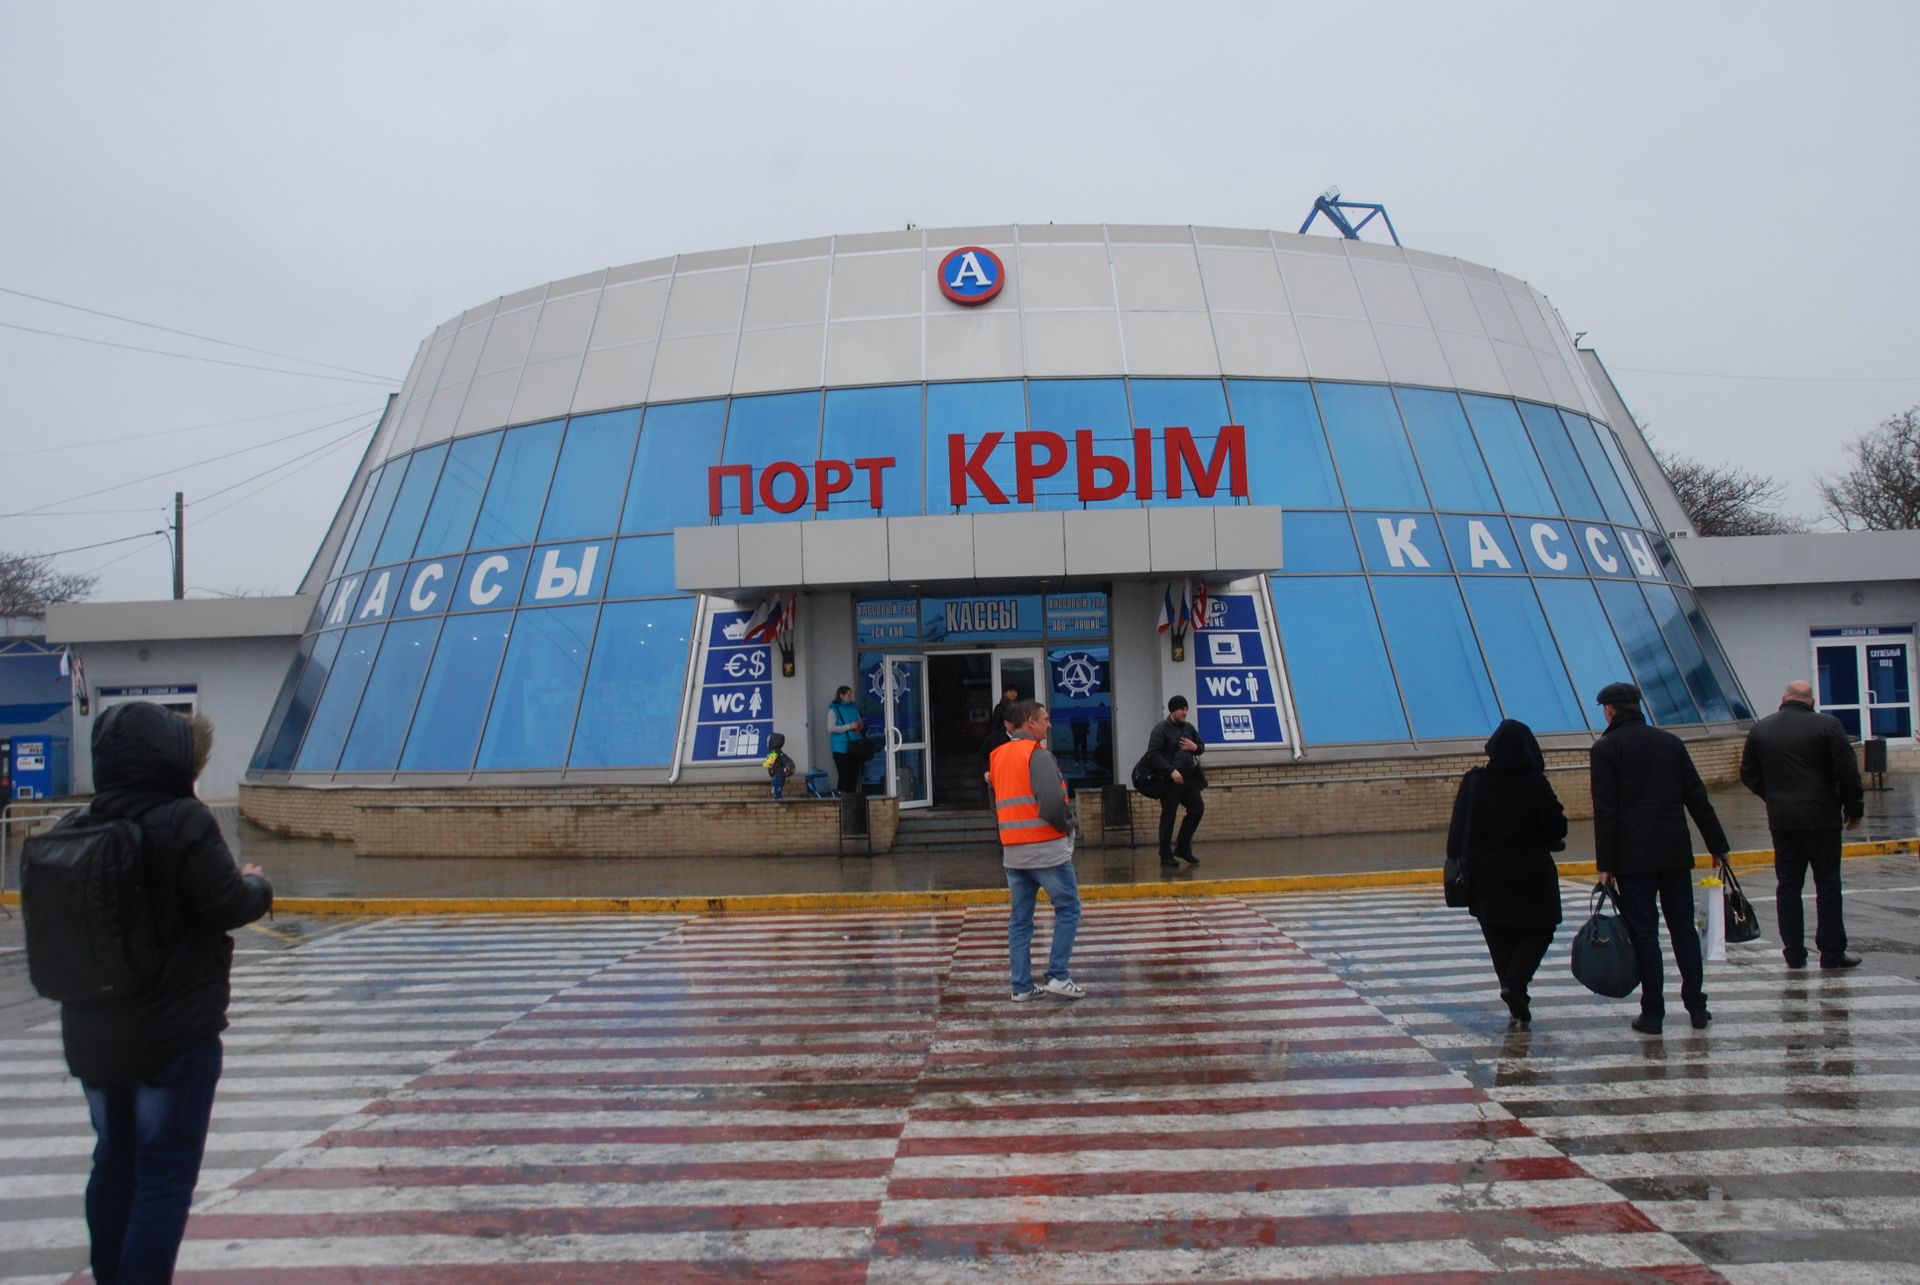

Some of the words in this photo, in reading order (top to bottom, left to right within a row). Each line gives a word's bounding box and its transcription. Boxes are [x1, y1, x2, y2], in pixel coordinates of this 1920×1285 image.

[708, 456, 896, 516] ПОРТ
[946, 425, 1248, 506] КРЫМ
[1375, 518, 1660, 578] КАССЫ
[329, 546, 600, 625] КАССЫ
[945, 600, 1018, 632] КАССЫ
[712, 692, 745, 714] WC
[1205, 676, 1242, 697] WC
